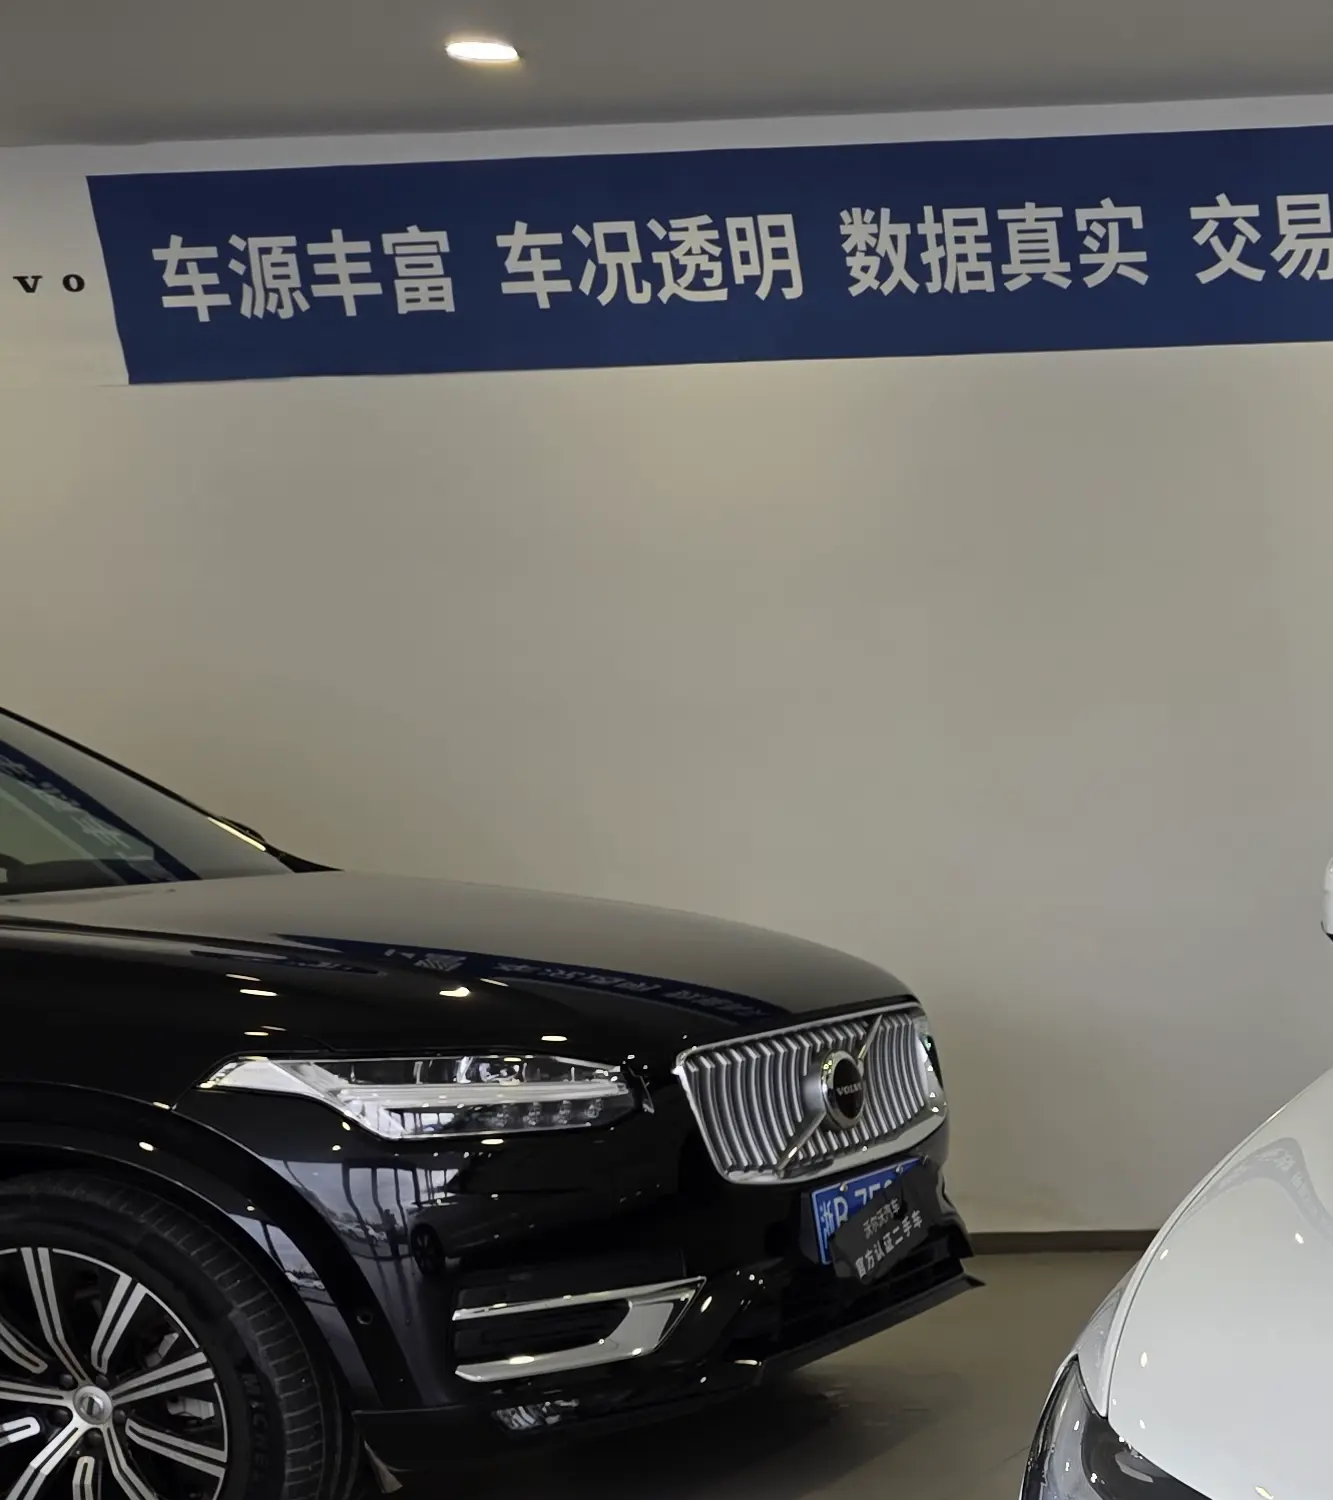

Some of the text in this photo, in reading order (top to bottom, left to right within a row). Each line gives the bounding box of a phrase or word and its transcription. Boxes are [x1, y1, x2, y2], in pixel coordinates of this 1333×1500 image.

[152, 224, 456, 323] 车源丰富
[495, 213, 804, 310] 车况透明
[839, 196, 1150, 298] 数据真实
[855, 1209, 923, 1280] 官方认证二手车
